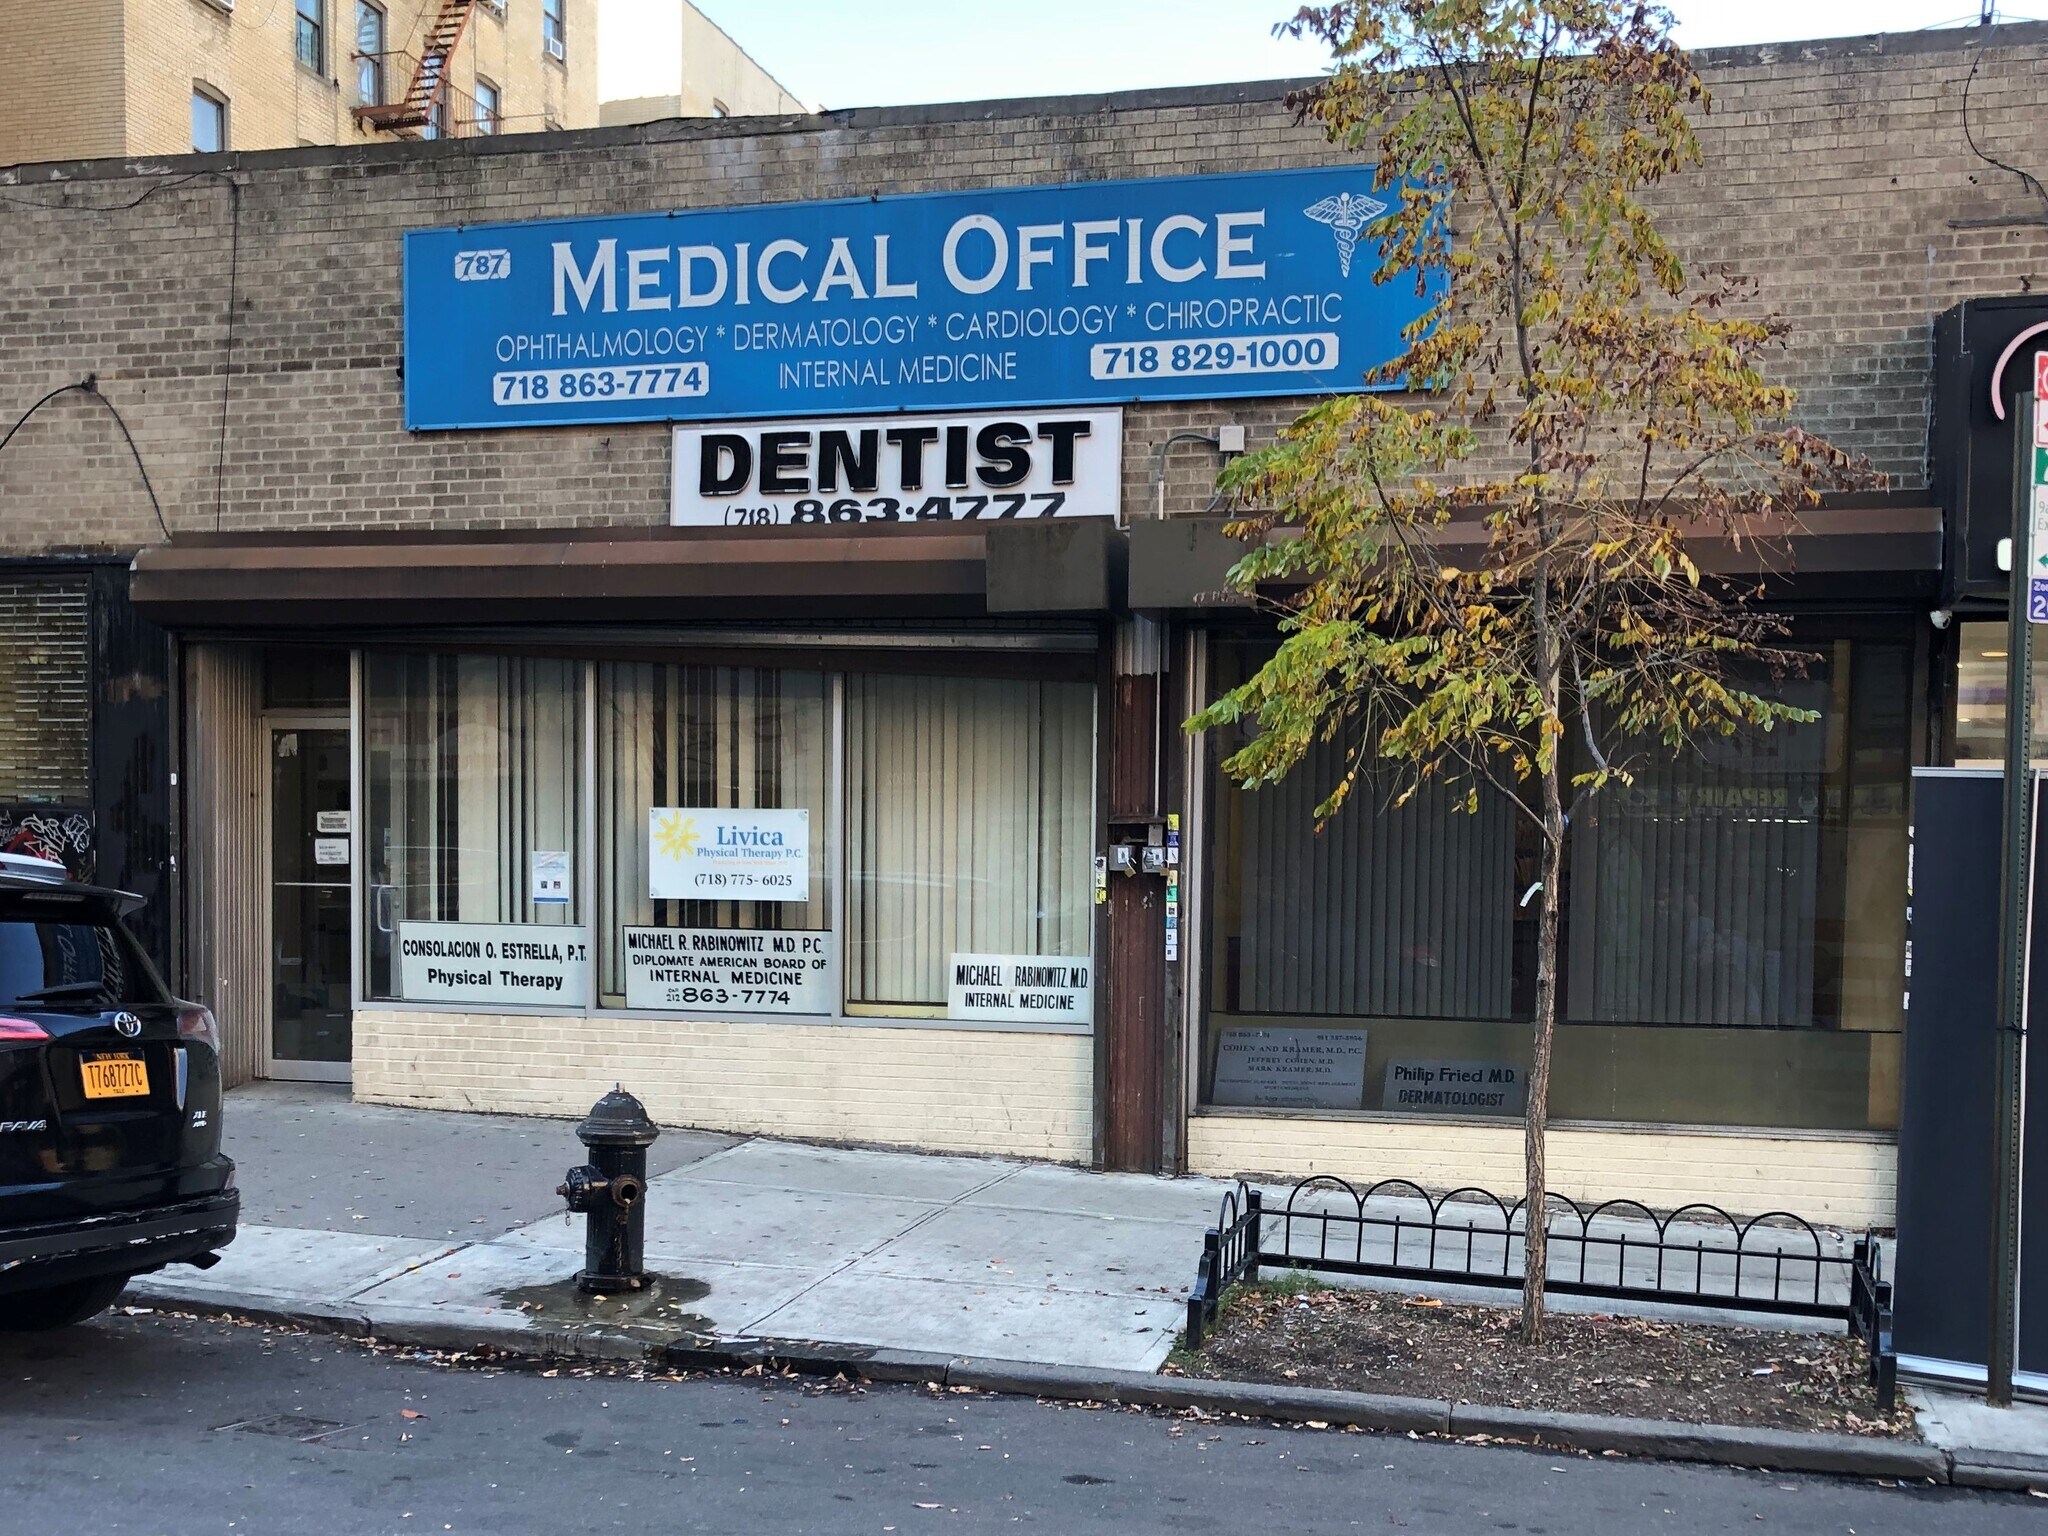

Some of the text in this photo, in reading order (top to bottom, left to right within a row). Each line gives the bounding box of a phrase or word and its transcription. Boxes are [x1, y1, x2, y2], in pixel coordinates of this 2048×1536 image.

[461, 252, 508, 278] 787
[552, 208, 1265, 316] MEDICAL OFFICE
[496, 325, 708, 363] OPHTHALMOLOGY
[734, 316, 919, 351] DERMATOLOGY
[945, 304, 1116, 341] CARDIOLOGY
[1144, 292, 1343, 331] CHIROPRACTIC
[1102, 338, 1326, 375] 718 829-1000
[780, 351, 1017, 389] INTERNAL MEDICINE
[500, 366, 702, 401] 718 863-7774
[699, 420, 1093, 497] DENTIST
[724, 503, 780, 526] (718)
[717, 826, 784, 846] Livica
[697, 847, 739, 859] Physical
[742, 848, 784, 860] Therapy
[694, 873, 727, 888] (718)
[762, 875, 793, 886] 6025
[403, 939, 481, 958] CONSOLACION
[486, 942, 497, 959] O.
[502, 943, 563, 964] ESTRELLA,
[628, 932, 675, 951] MICHAEL
[692, 934, 765, 953] RABINOWITZ
[632, 954, 828, 971] DIPLOMATE AMERICAN BOARD OF
[428, 968, 563, 991] Physical Therapy
[649, 970, 804, 987] INTERNAL MEDICINE
[956, 964, 1003, 986] MICHAEL
[666, 987, 791, 1006] 212 863-7774
[964, 992, 1075, 1010] INTERNAL MEDICINE
[1259, 1045, 1279, 1053] AND
[87, 1063, 143, 1089] T768727C
[1395, 1066, 1435, 1085] Philip
[1440, 1068, 1483, 1082] Fried
[1398, 1089, 1505, 1107] DERMATOLOGIST
